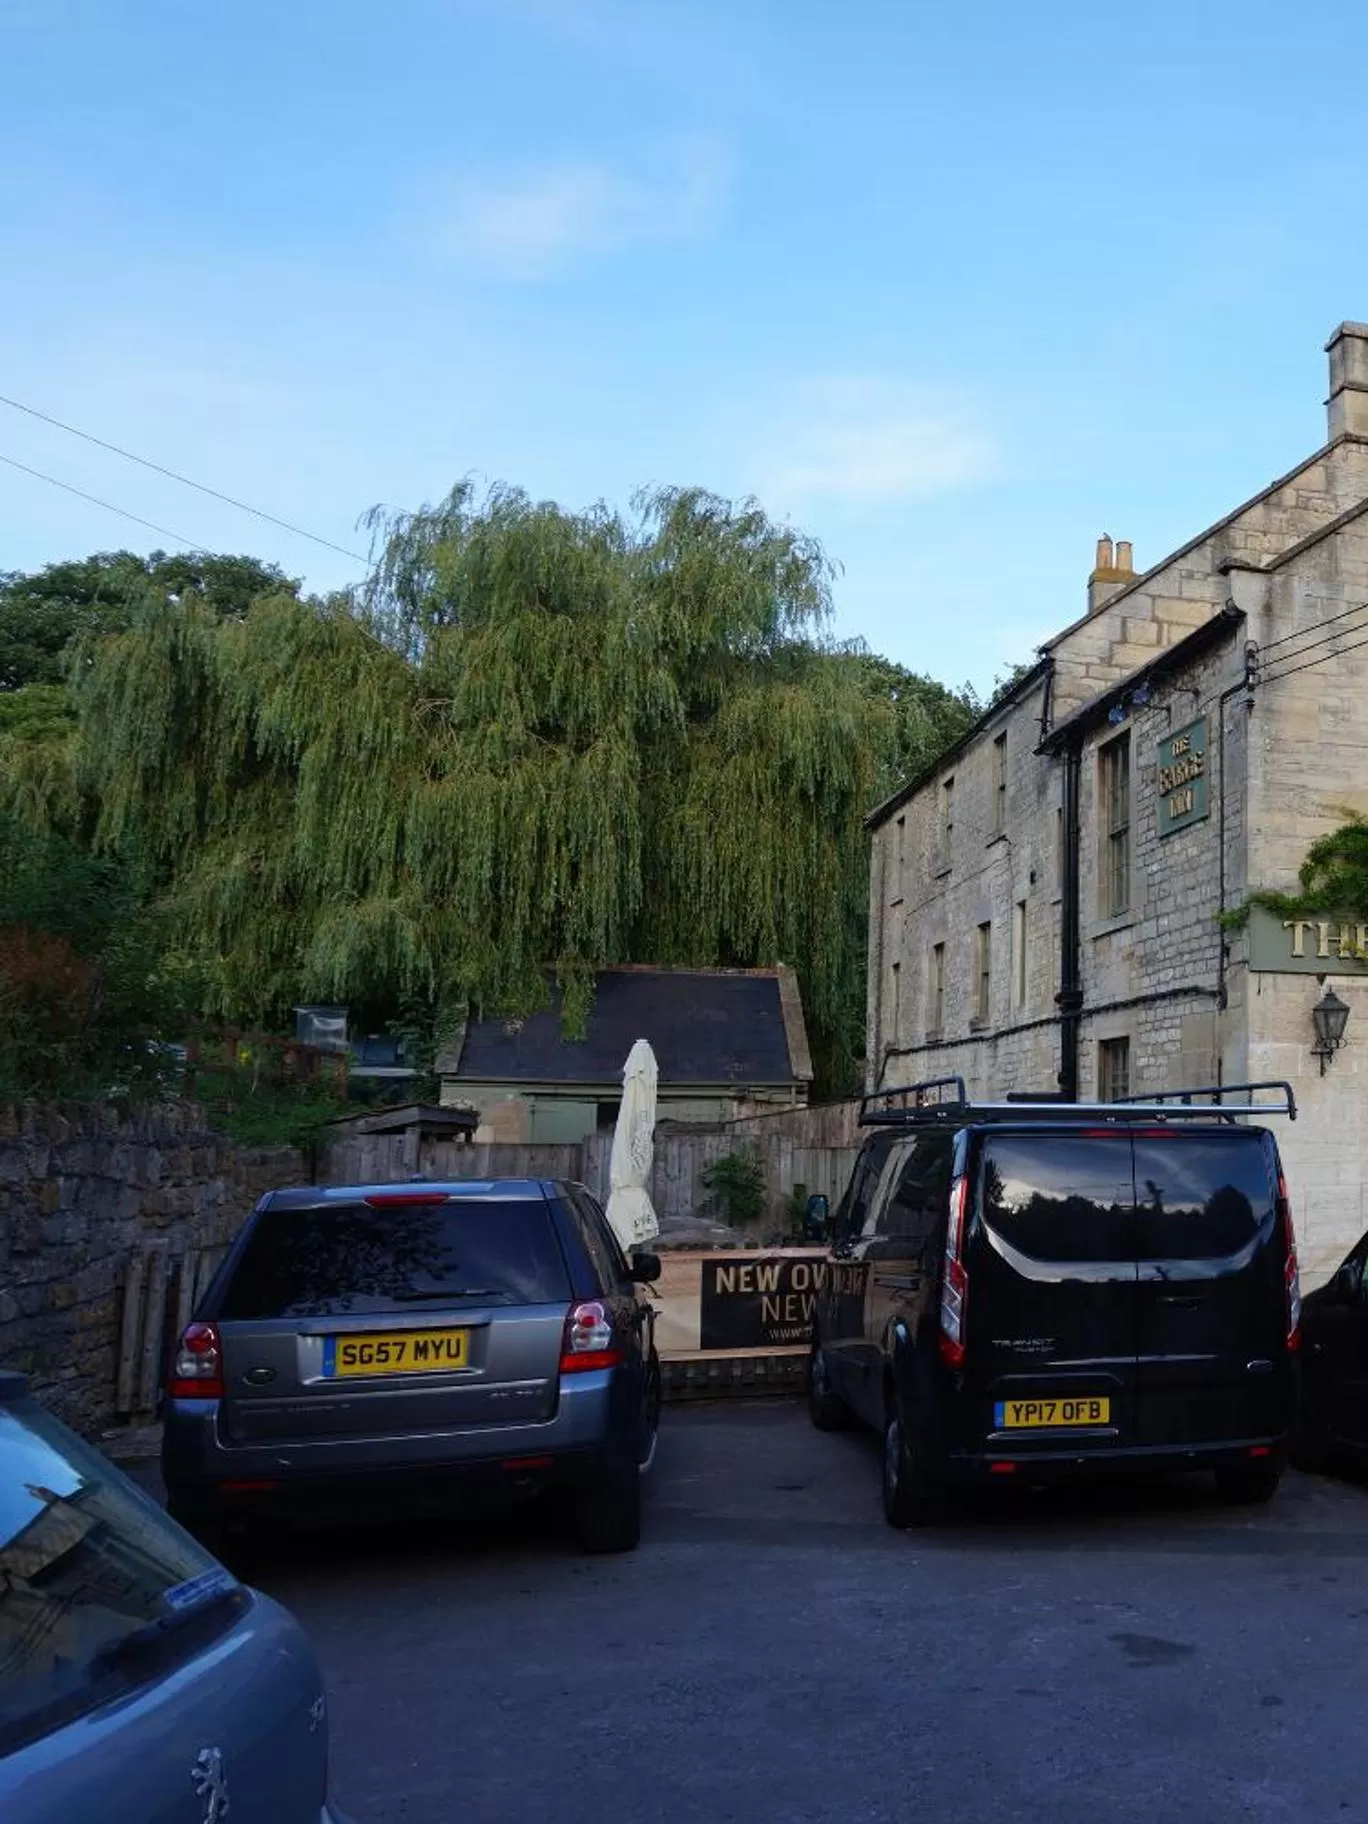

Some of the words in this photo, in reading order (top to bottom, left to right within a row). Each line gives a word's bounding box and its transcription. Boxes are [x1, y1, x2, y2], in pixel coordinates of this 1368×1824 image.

[1170, 734, 1190, 756] THE
[1170, 789, 1192, 818] INN
[715, 1264, 780, 1294] NEW
[342, 1341, 407, 1366] SG57
[413, 1338, 461, 1362] MYU
[1011, 1403, 1056, 1423] YP17
[1062, 1401, 1101, 1421] OFB
